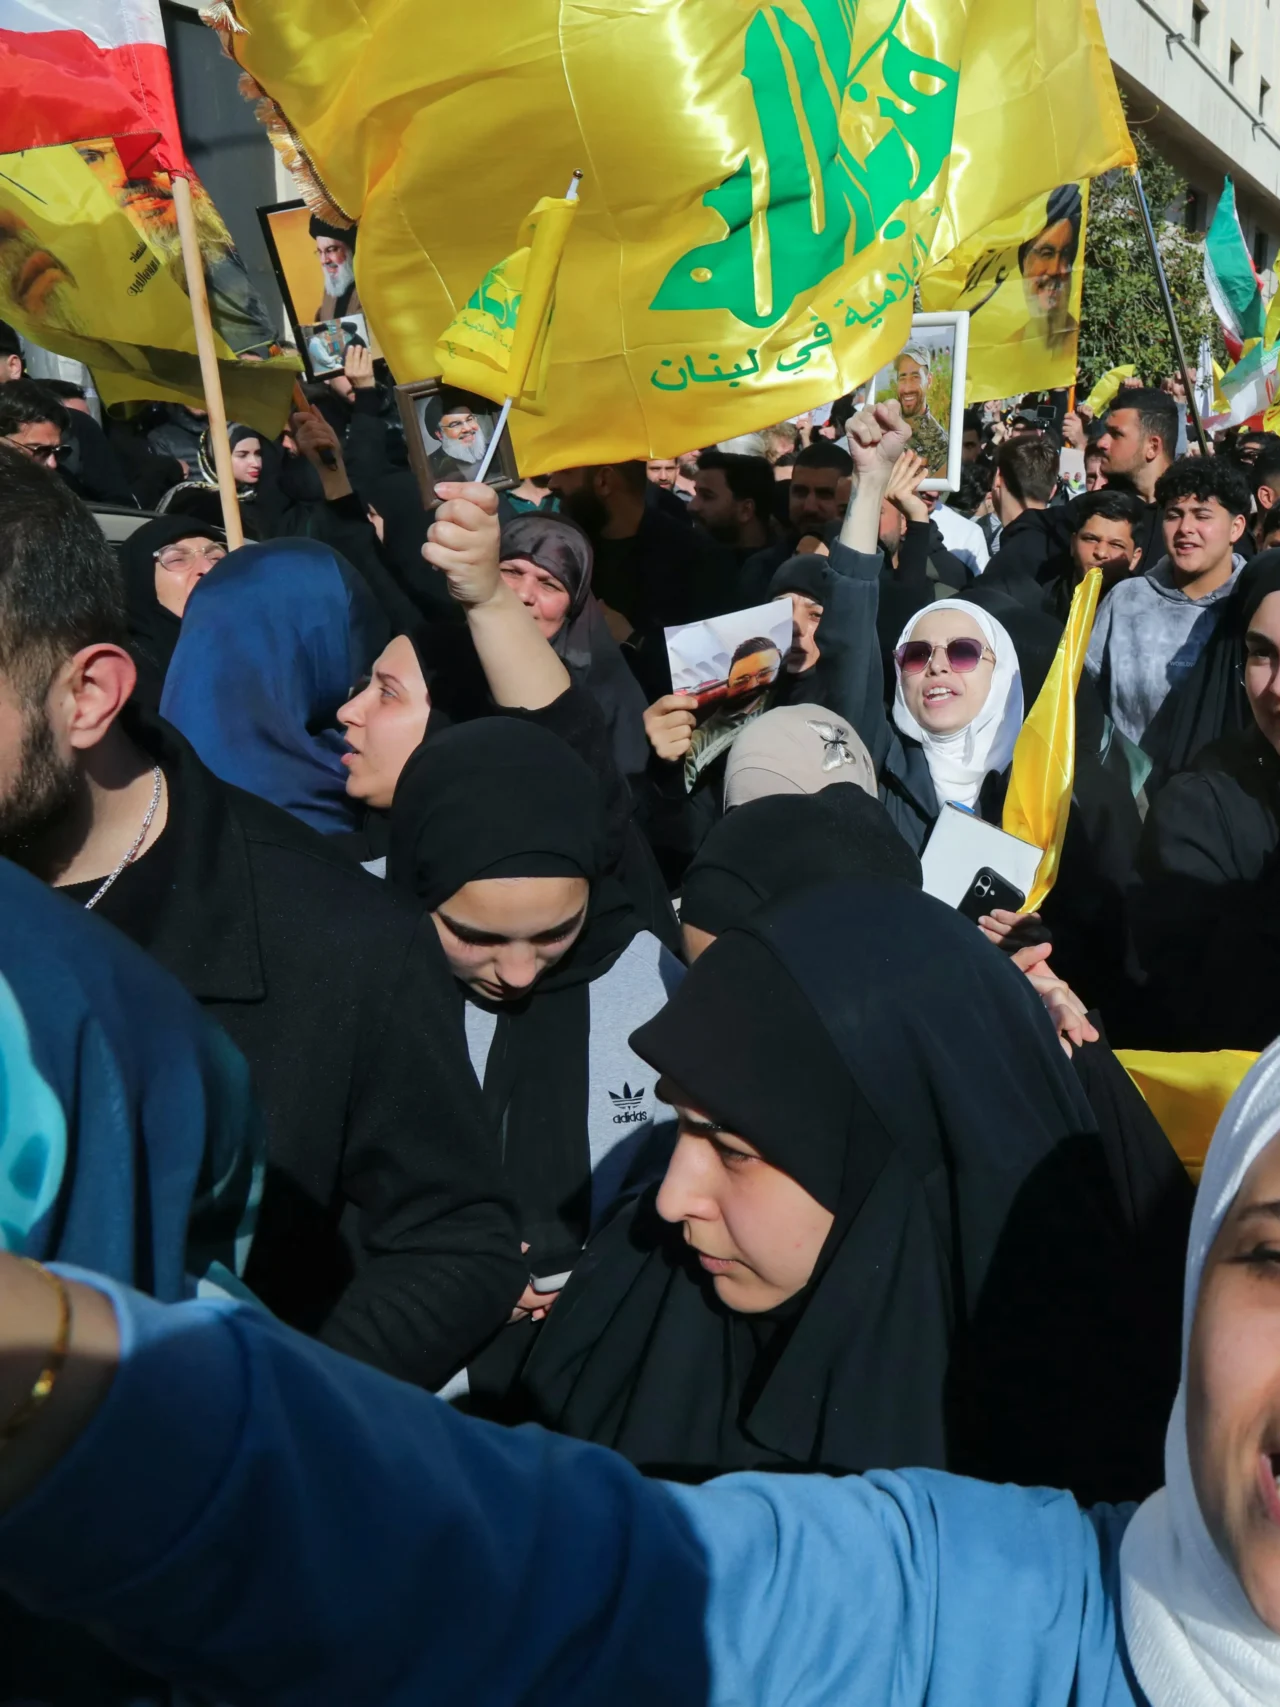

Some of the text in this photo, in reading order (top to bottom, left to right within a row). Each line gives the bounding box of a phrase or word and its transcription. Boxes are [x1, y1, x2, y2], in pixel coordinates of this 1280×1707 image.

[776, 315, 833, 373] في
[650, 348, 760, 391] لبنان
[612, 1110, 647, 1124] adidas
